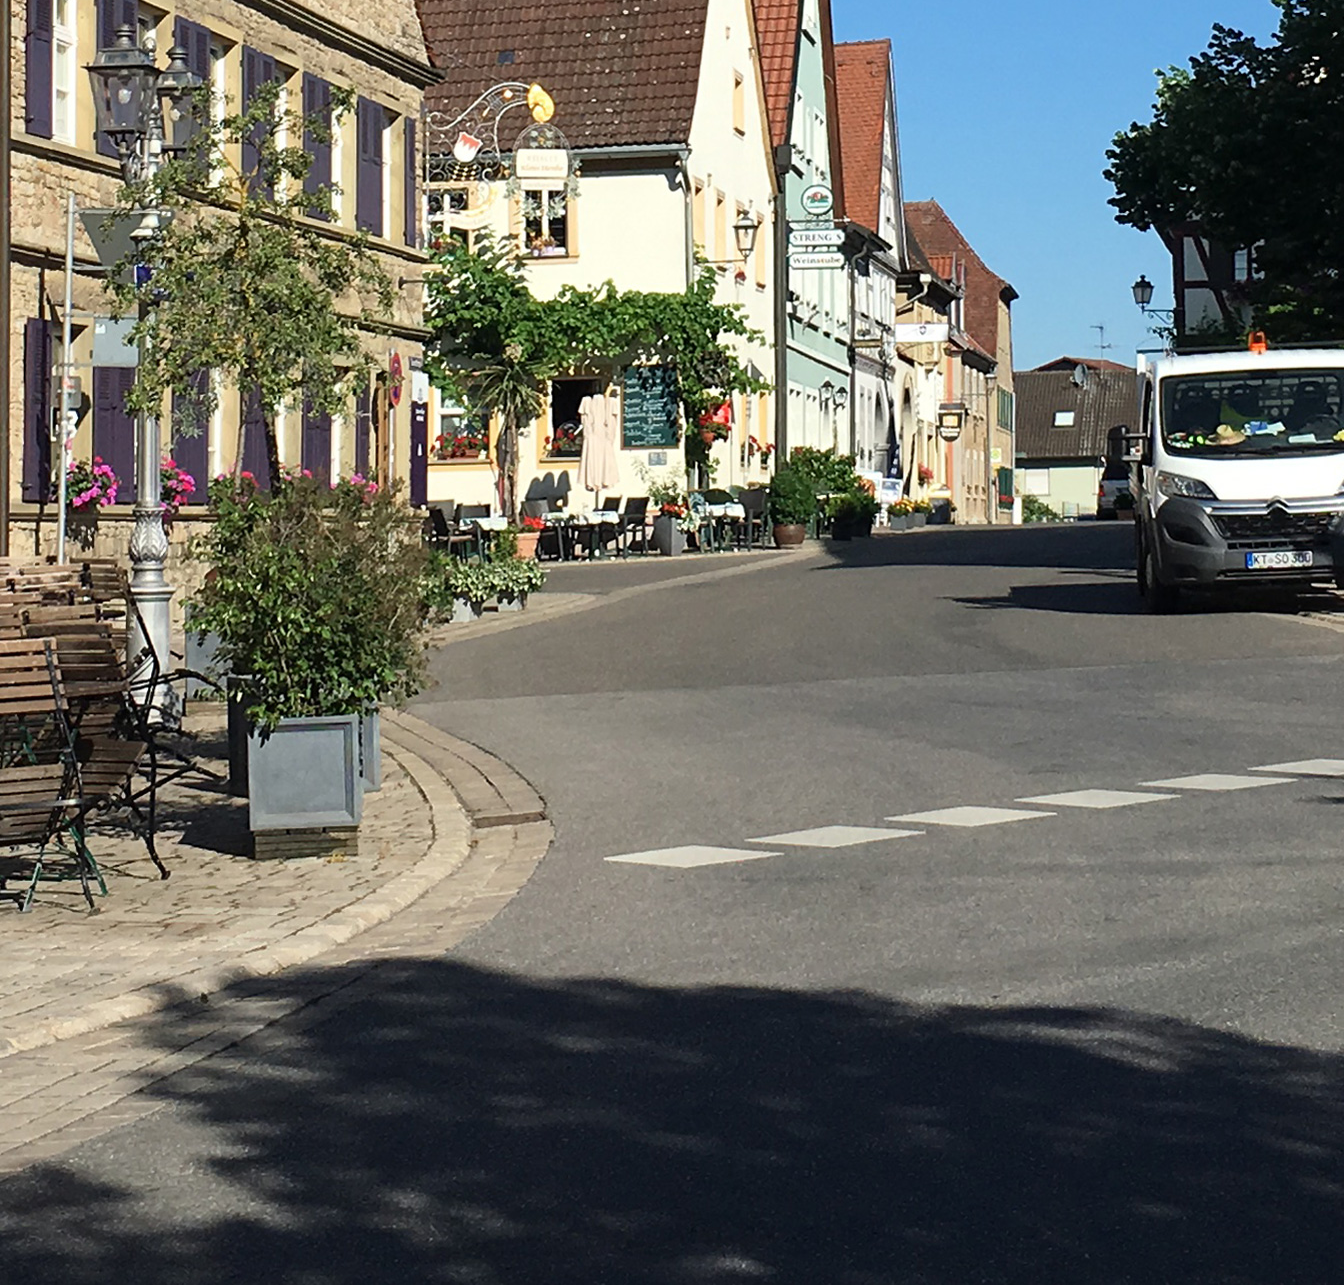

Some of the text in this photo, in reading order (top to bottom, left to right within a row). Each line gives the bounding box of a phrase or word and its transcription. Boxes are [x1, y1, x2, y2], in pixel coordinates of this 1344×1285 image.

[792, 234, 843, 242] STRENGS
[792, 256, 842, 265] Weinstube
[1253, 554, 1268, 567] KT
